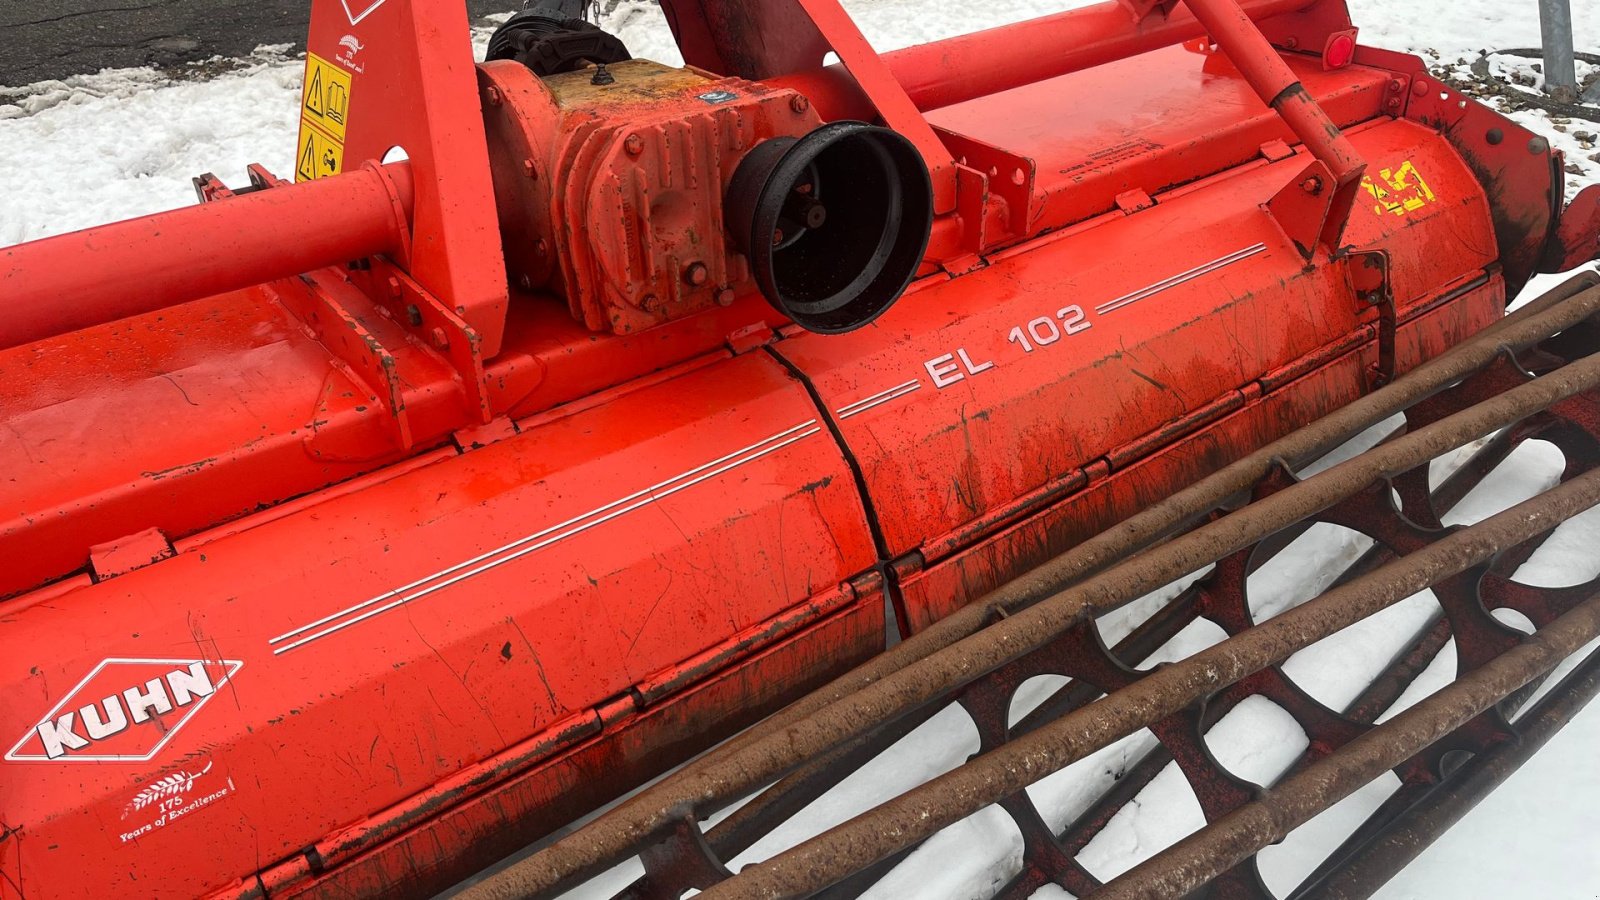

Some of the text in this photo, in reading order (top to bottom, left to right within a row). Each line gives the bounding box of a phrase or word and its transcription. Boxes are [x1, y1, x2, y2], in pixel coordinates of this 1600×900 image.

[924, 304, 1092, 389] EL 102
[36, 660, 215, 760] KUHN
[120, 788, 228, 842] Years of Excellence
[159, 796, 183, 813] 175
